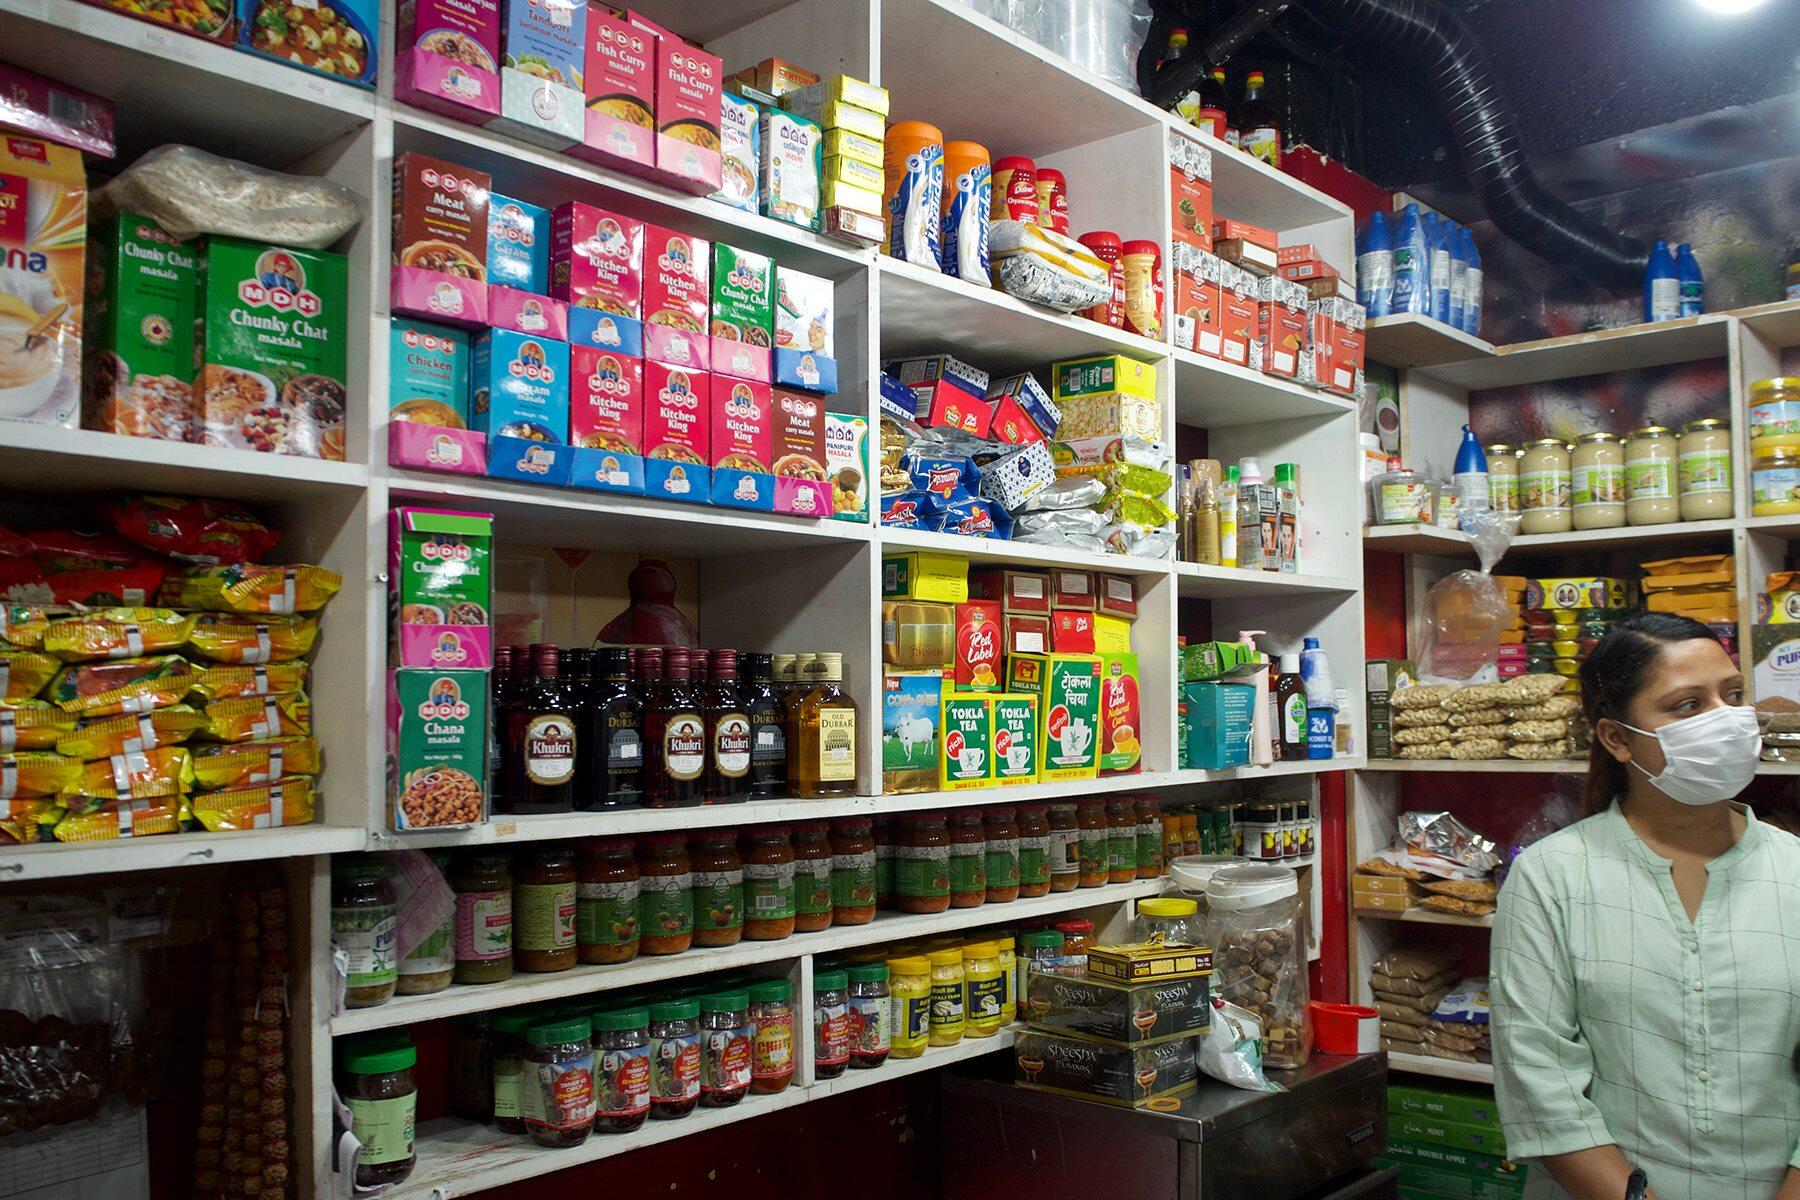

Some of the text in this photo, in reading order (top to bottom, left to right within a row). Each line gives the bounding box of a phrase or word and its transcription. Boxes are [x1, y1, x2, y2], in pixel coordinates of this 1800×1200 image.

[600, 26, 643, 52] MDH
[596, 42, 646, 71] Fish Curry
[608, 60, 635, 75] masala
[671, 54, 712, 78] MDH
[669, 68, 714, 95] Fish Curry
[680, 85, 703, 100] masala
[434, 192, 465, 211] Meat
[426, 205, 471, 222] curry masala
[980, 186, 992, 260] Horlicks
[125, 241, 193, 269] Chunky Chat
[140, 265, 178, 281] masala
[589, 255, 628, 275] Kitchen
[597, 269, 619, 285] King
[659, 273, 696, 291] Kitchen
[729, 274, 763, 292] MDH
[245, 283, 318, 314] MDH
[668, 286, 688, 300] King
[721, 285, 750, 302] Chunky
[733, 301, 756, 312] masala
[230, 308, 328, 341] Chunky Chat
[258, 332, 302, 349] masala
[405, 331, 455, 353] MDH
[407, 353, 453, 372] Chicken
[511, 362, 553, 382] MDH
[590, 376, 629, 395] MDH
[589, 395, 628, 411] Kitchen
[661, 390, 697, 408] MDH
[599, 407, 620, 421] King
[660, 407, 696, 423] Kitchen
[726, 402, 760, 420] MDH
[668, 419, 688, 433] King
[726, 420, 760, 434] Kitchen
[790, 416, 810, 428] Meat
[734, 431, 753, 444] King
[798, 428, 815, 436] masala
[826, 443, 853, 452] PANIPURI
[828, 450, 852, 458] MASALA
[423, 543, 470, 559] MDH
[970, 631, 992, 648] Red
[968, 642, 993, 664] Label
[1011, 681, 1041, 691] TOKLA TEA
[1061, 671, 1092, 689] टोकला
[1110, 682, 1125, 695] Red
[1065, 690, 1088, 706] चिया
[1109, 692, 1126, 709] Label
[421, 703, 468, 720] MDH
[763, 708, 775, 717] OLD
[952, 708, 984, 719] TOKLA
[1000, 708, 1030, 719] TOKLA
[1108, 702, 1131, 720] Natural
[753, 715, 785, 724] DURBAR
[821, 718, 852, 728] DURBAR
[960, 720, 977, 731] TEA
[1008, 720, 1024, 730] TEA
[1112, 716, 1127, 728] Care
[424, 722, 465, 735] Chana
[427, 736, 460, 744] masala
[533, 740, 571, 754] Khukri
[671, 738, 702, 751] Khukri
[721, 736, 749, 749] Khukri
[948, 737, 963, 752] rich
[996, 735, 1011, 751] rich
[1417, 1148, 1466, 1165] DOUBLE APPLE
